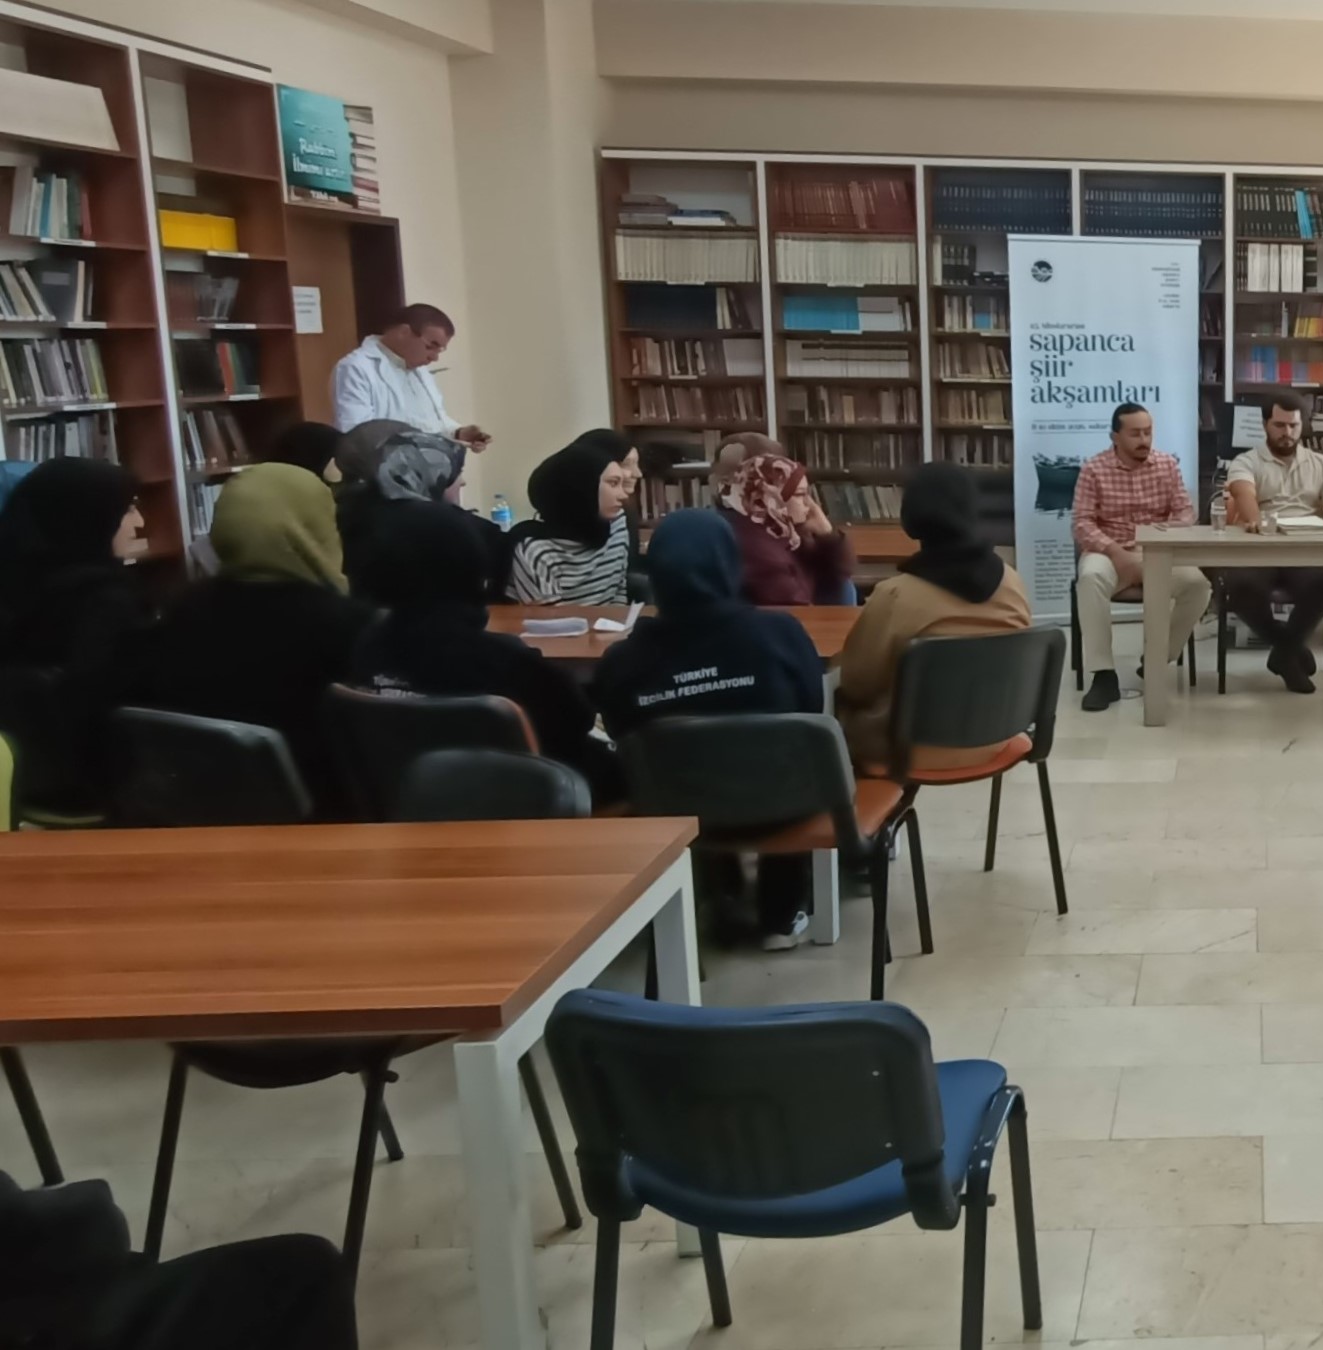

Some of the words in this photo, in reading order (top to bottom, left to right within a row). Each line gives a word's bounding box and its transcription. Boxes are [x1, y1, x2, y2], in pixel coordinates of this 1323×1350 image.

[1029, 333, 1136, 356] sapanca
[1030, 354, 1073, 383] şiir
[1030, 380, 1160, 409] akşamları
[673, 666, 718, 684] TÜRKİYE
[678, 675, 755, 697] FEDERASYONU
